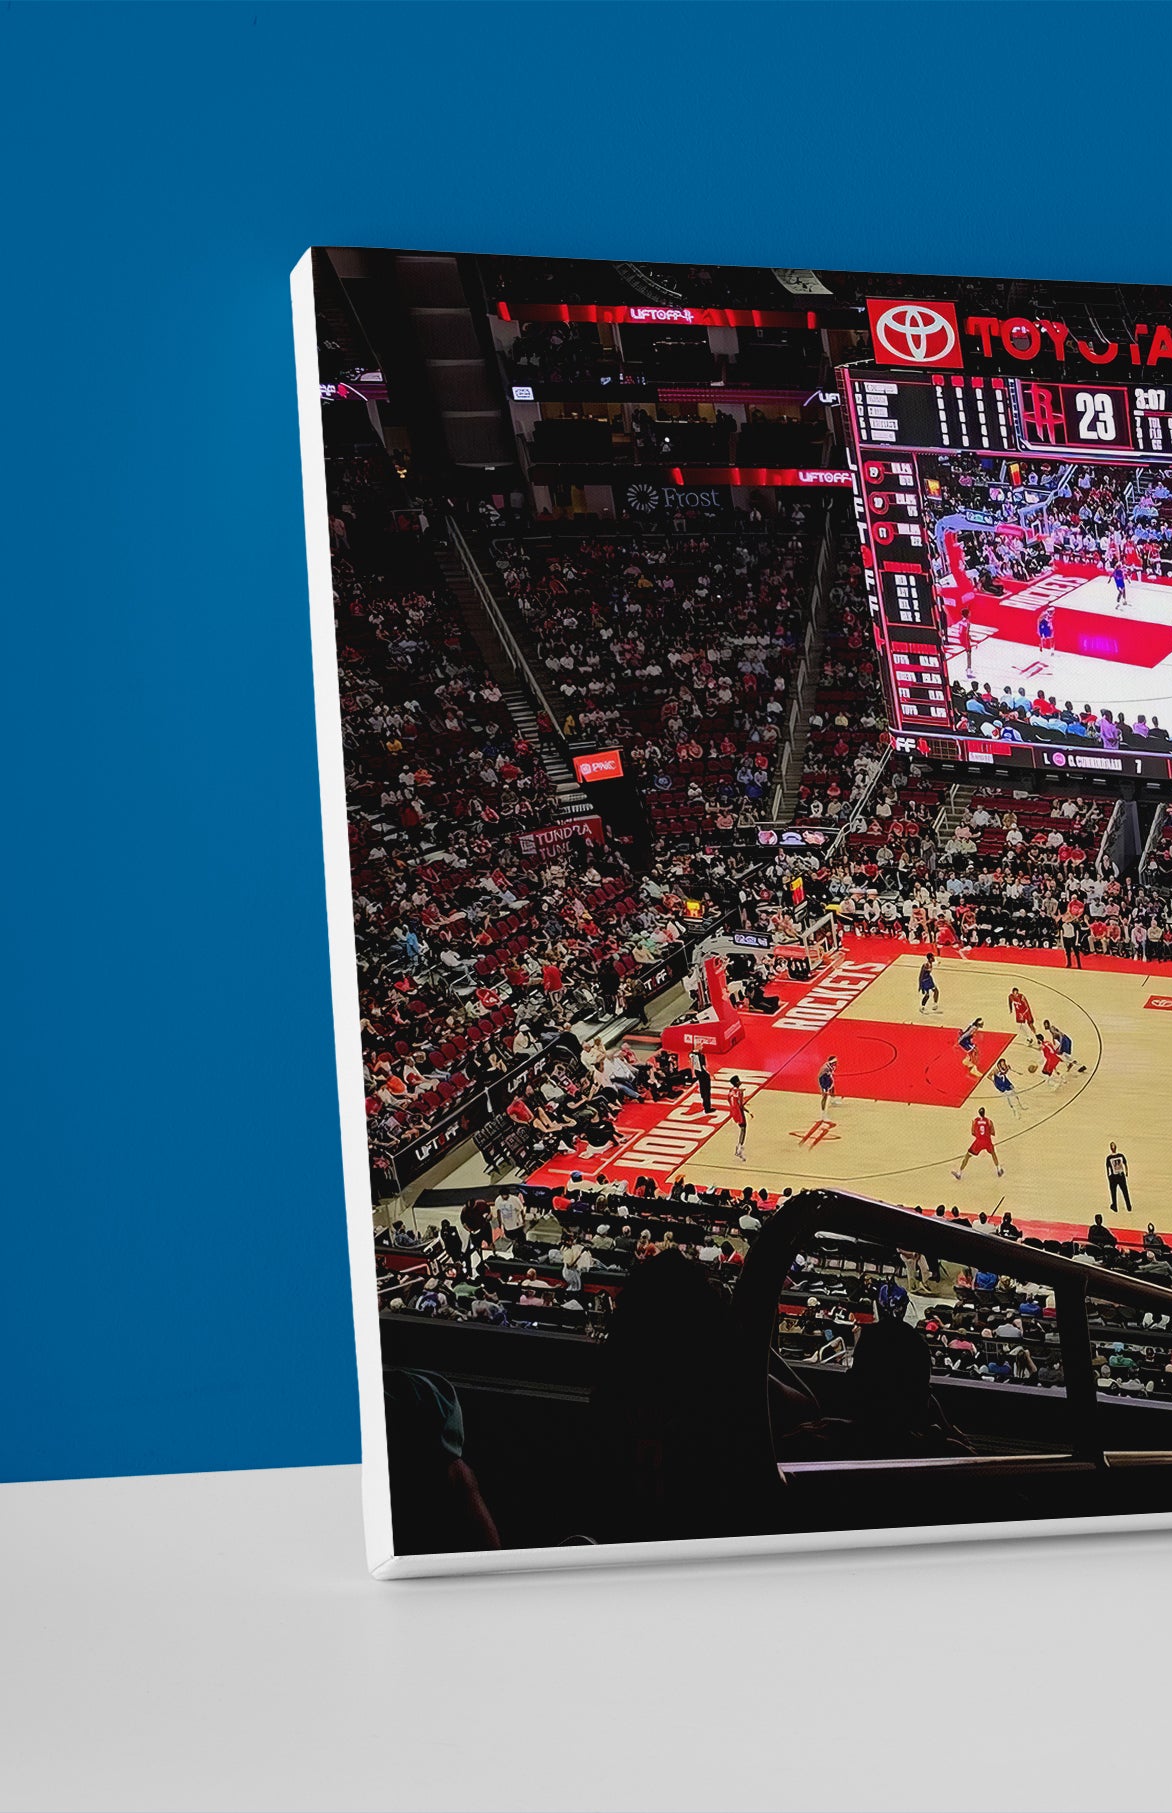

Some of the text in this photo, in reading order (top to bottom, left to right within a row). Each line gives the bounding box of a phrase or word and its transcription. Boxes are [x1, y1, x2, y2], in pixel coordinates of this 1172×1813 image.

[1075, 392, 1118, 441] 23
[661, 487, 721, 508] Frost
[772, 961, 887, 1032] ROCKETS
